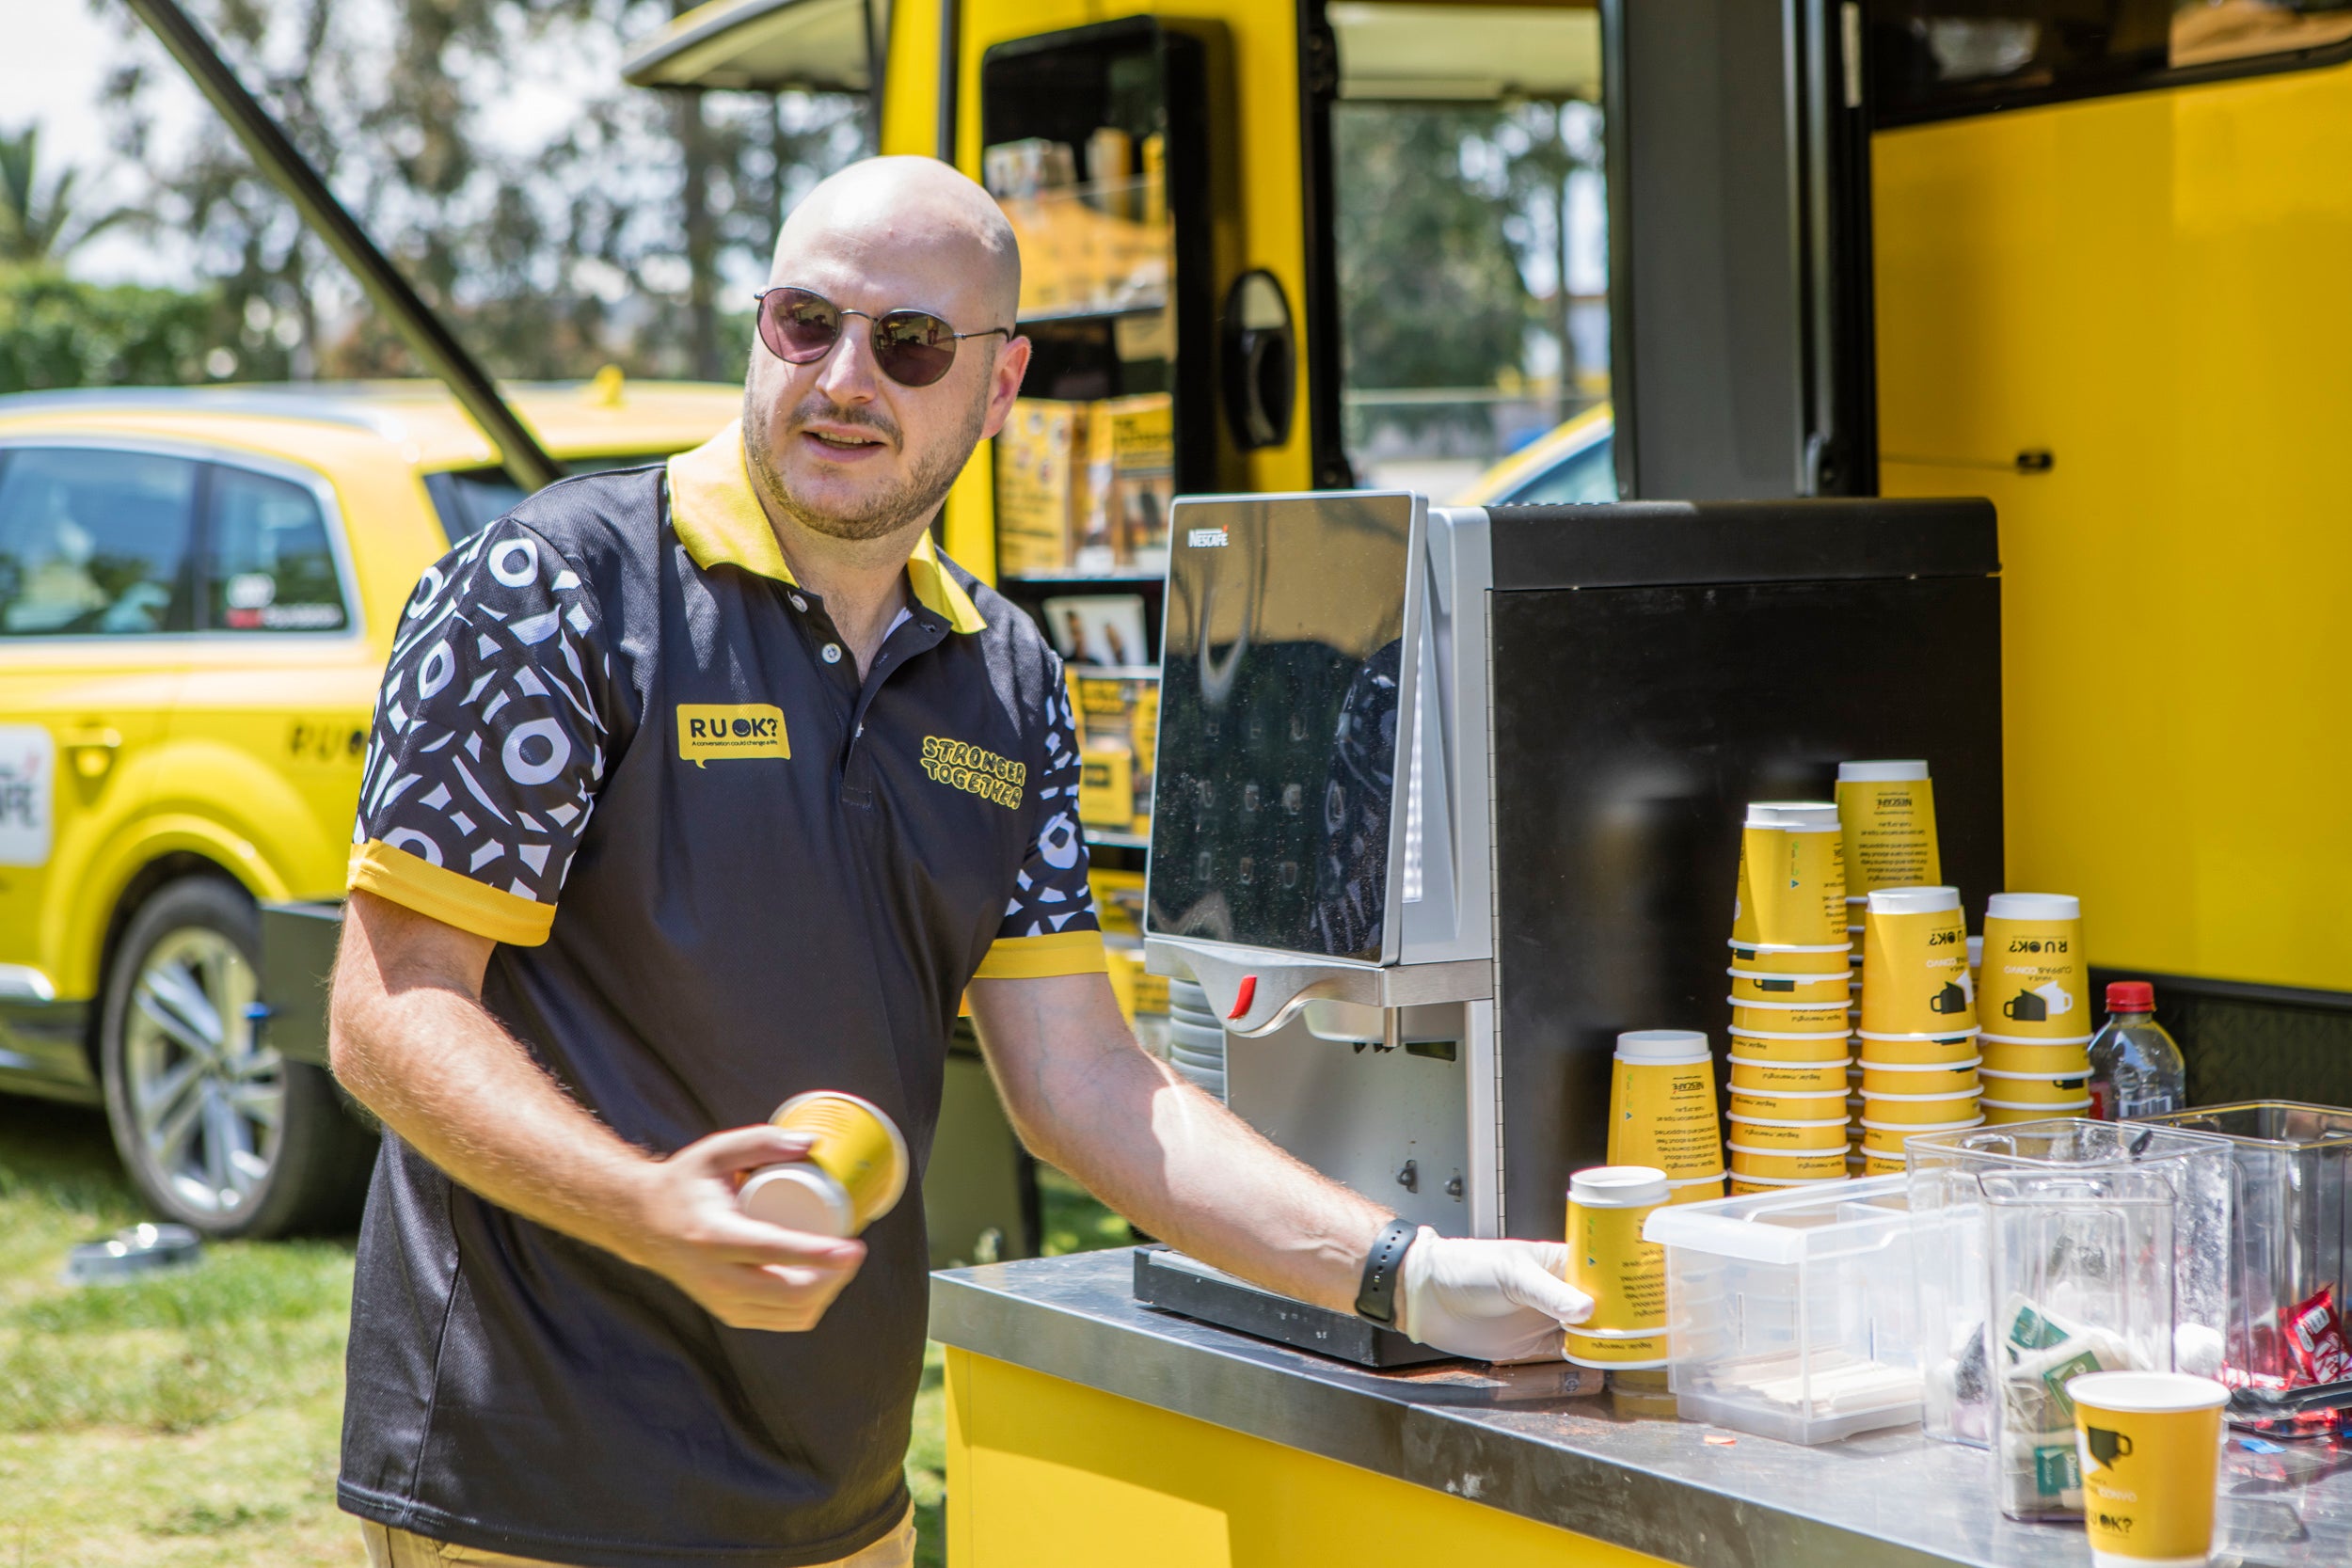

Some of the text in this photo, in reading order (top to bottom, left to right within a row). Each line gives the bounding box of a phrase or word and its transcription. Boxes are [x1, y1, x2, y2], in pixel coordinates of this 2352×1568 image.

[690, 718, 777, 738] R U OK?
[922, 735, 1026, 787] STRONGER
[920, 758, 1023, 810] TOGETHER
[2009, 941, 2067, 953] R U OK?
